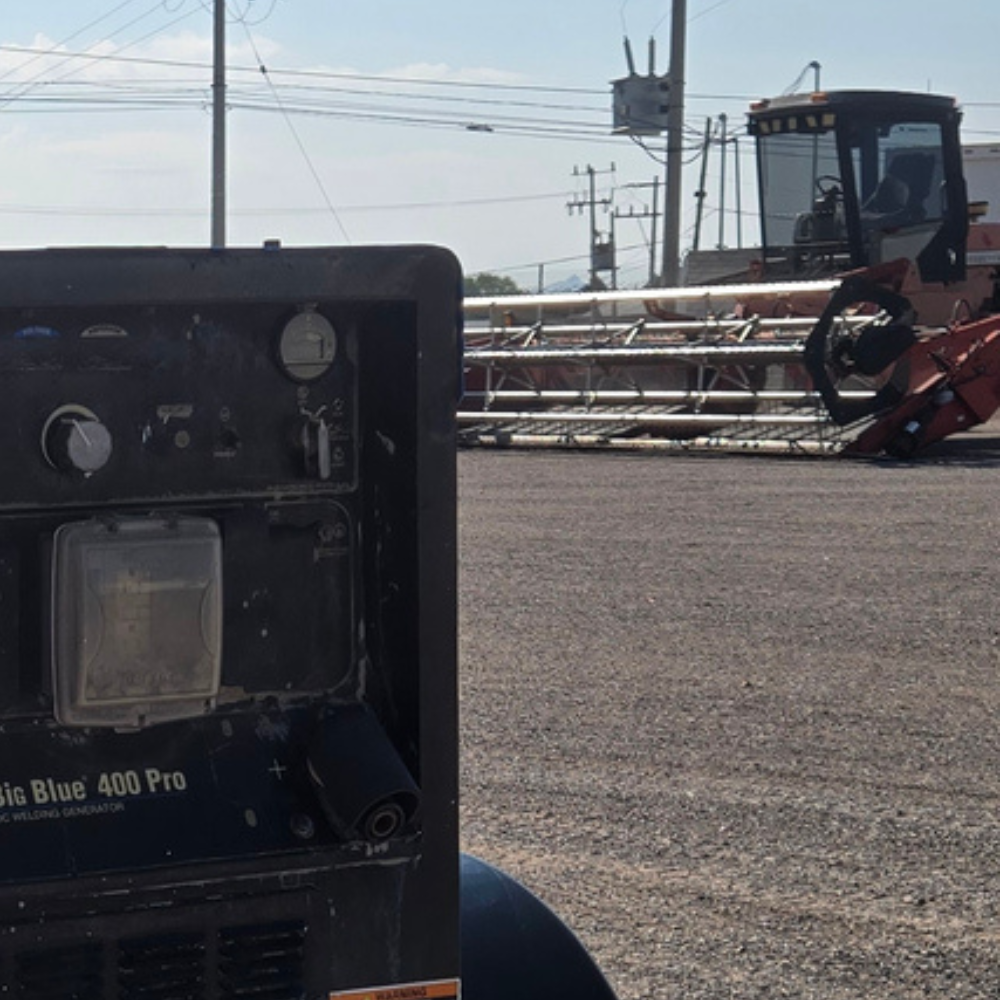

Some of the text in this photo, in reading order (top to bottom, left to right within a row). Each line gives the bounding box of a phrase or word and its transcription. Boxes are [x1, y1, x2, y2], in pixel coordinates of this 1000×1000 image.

[30, 777, 87, 804] Blue
[97, 769, 142, 798] 400
[144, 767, 188, 793] Pro
[13, 807, 61, 822] WELDING
[63, 802, 125, 818] GENERATOR
